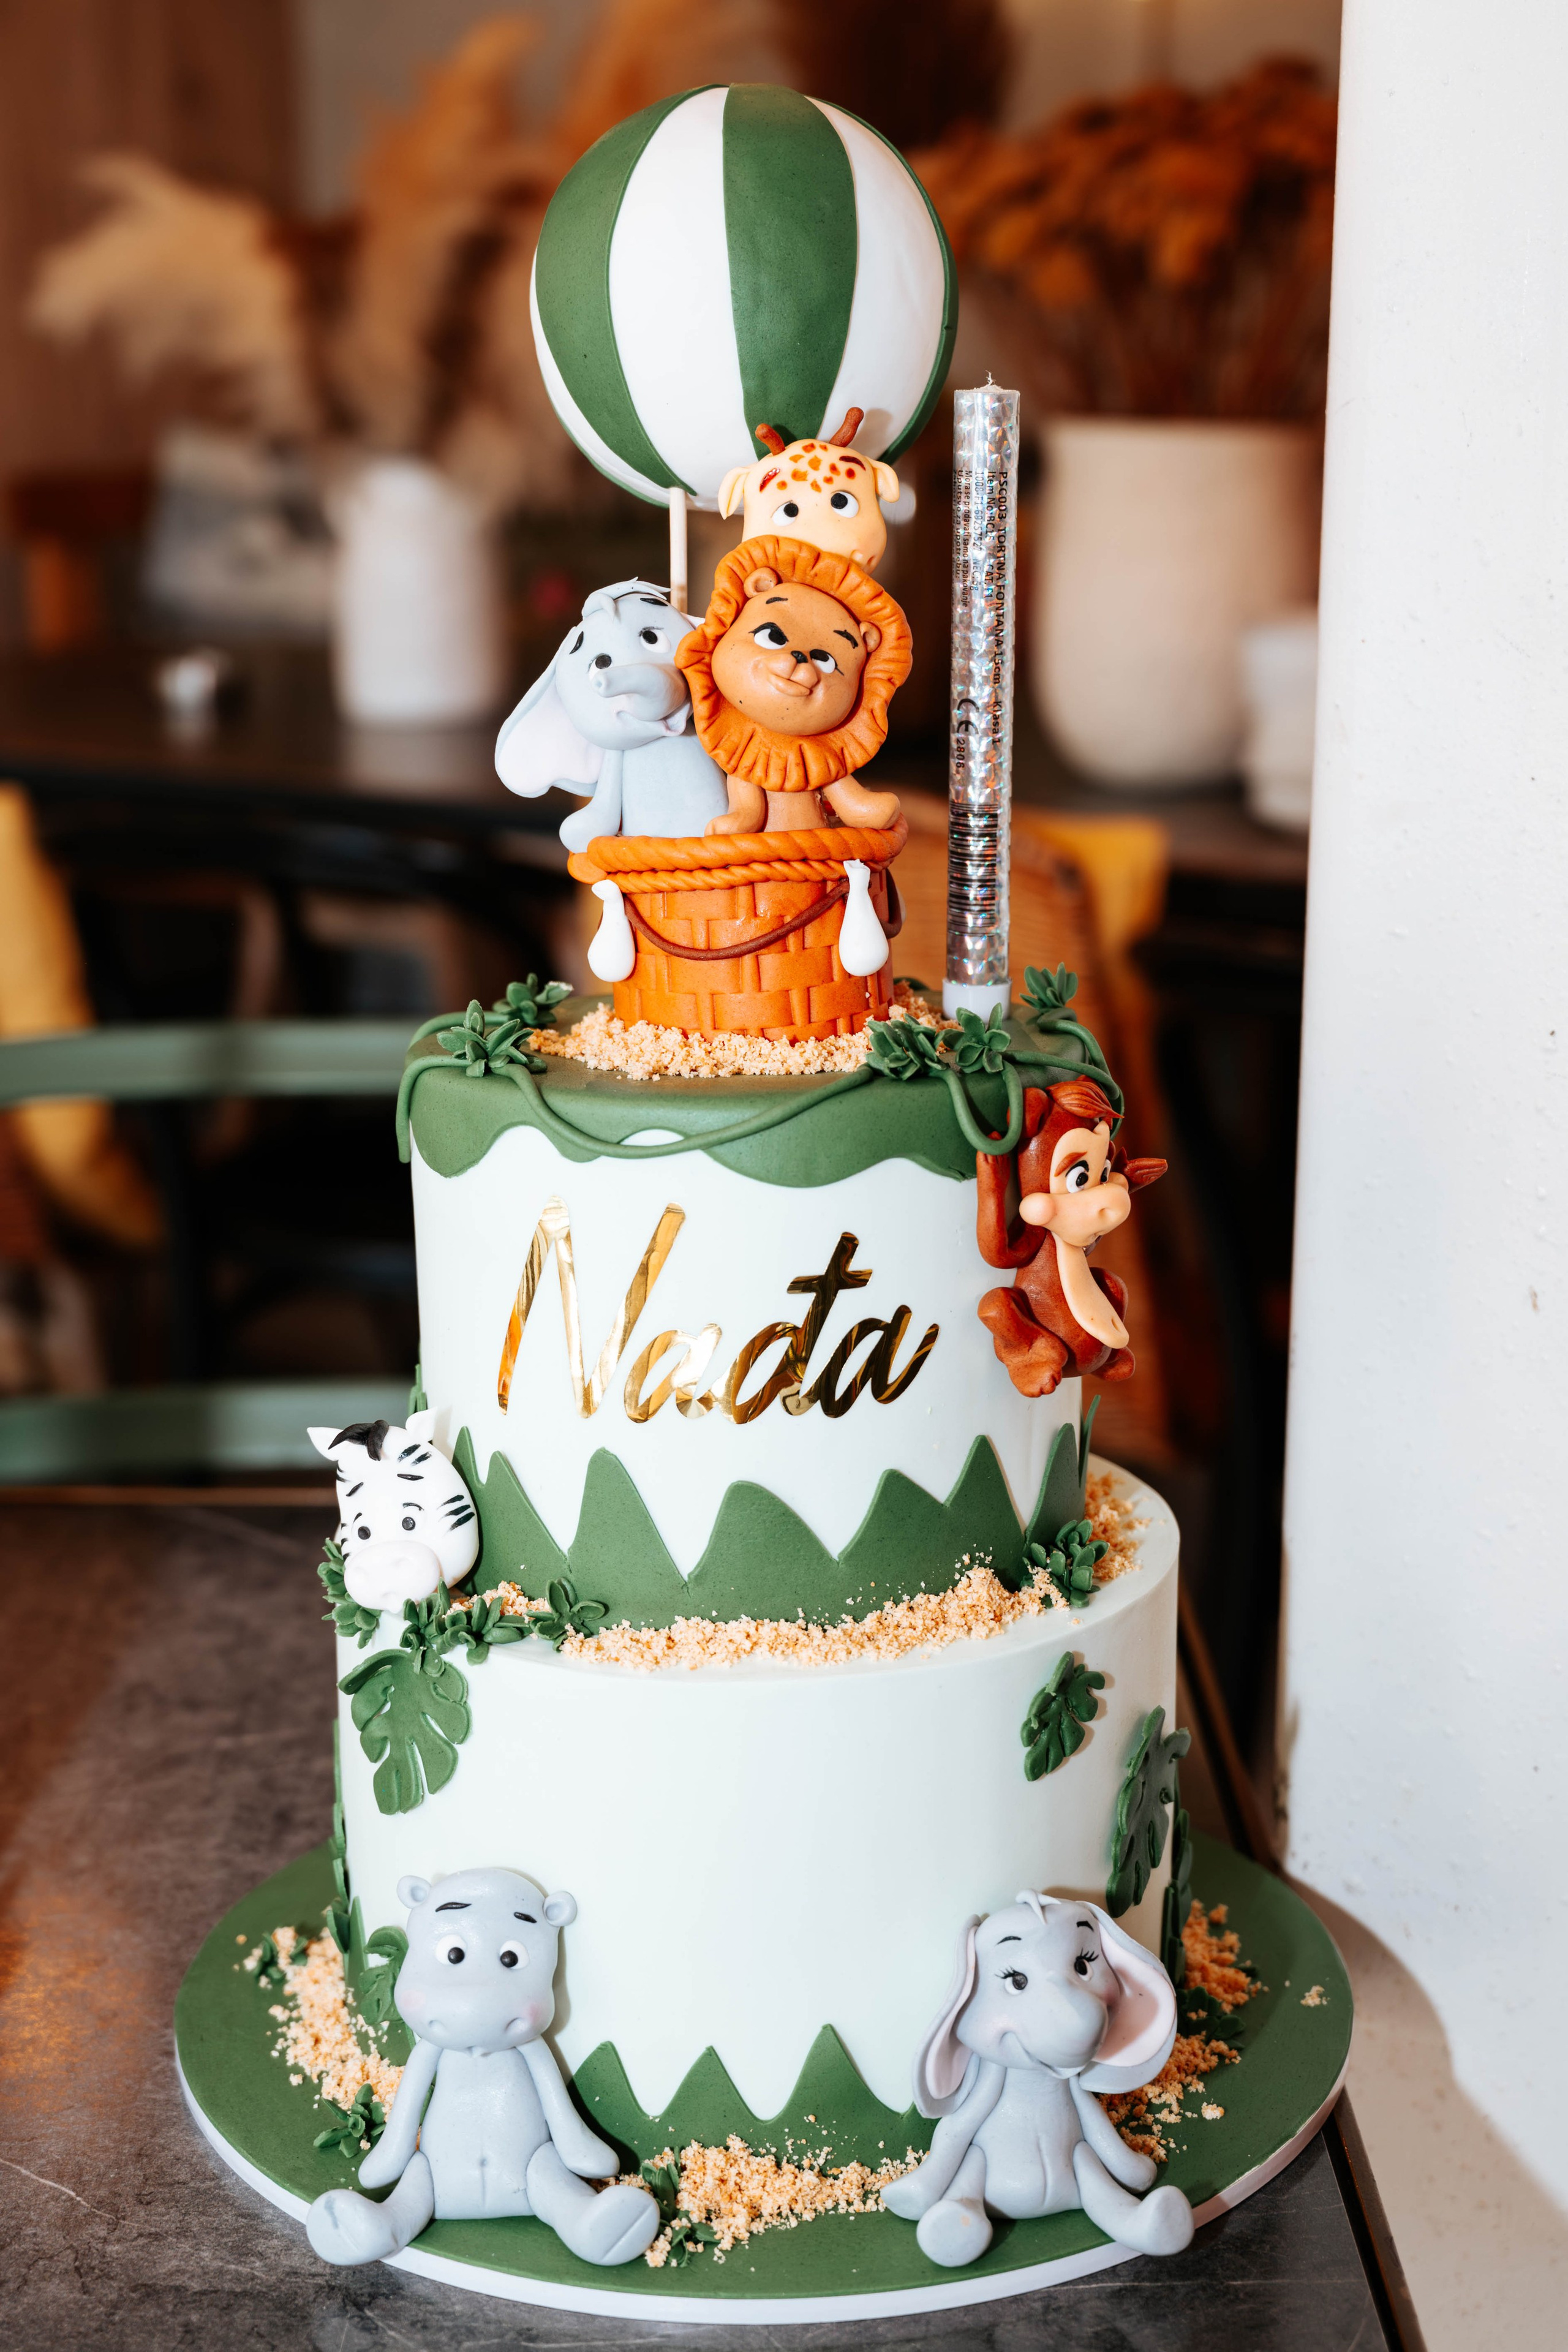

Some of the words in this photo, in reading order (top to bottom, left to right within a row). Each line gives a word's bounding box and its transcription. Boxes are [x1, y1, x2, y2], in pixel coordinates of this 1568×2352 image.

[964, 491, 970, 499] se
[987, 471, 996, 494] Item
[998, 472, 1008, 519] PSC003
[956, 515, 961, 525] za
[963, 501, 972, 537] prodavati
[962, 559, 968, 568] na
[997, 527, 1006, 581] TORTNA
[960, 570, 970, 607] pakovanje
[995, 584, 1005, 647] FONTANA
[993, 651, 1003, 685] 15cm
[992, 701, 1001, 734] Klasa
[956, 738, 965, 768] 2806
